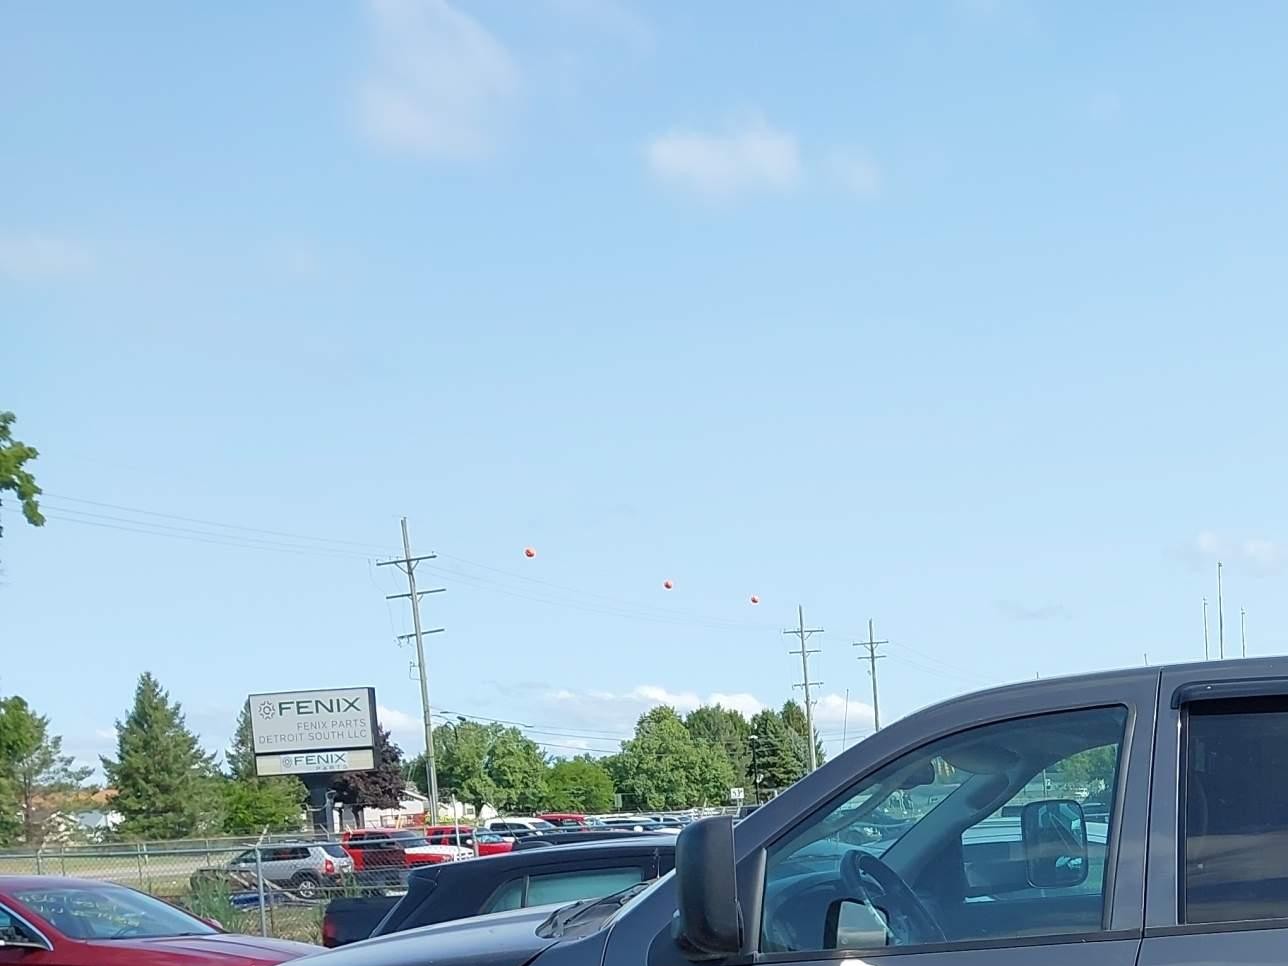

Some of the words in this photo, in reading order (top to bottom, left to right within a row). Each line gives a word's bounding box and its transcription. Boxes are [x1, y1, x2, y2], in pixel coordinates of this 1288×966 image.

[278, 697, 361, 717] FENIX
[296, 721, 328, 731] FENIX
[332, 718, 366, 729] PARTS
[258, 732, 304, 745] DETROIT
[309, 730, 344, 741] SOUTH
[348, 729, 367, 739] LLC
[294, 753, 346, 766] FENIX
